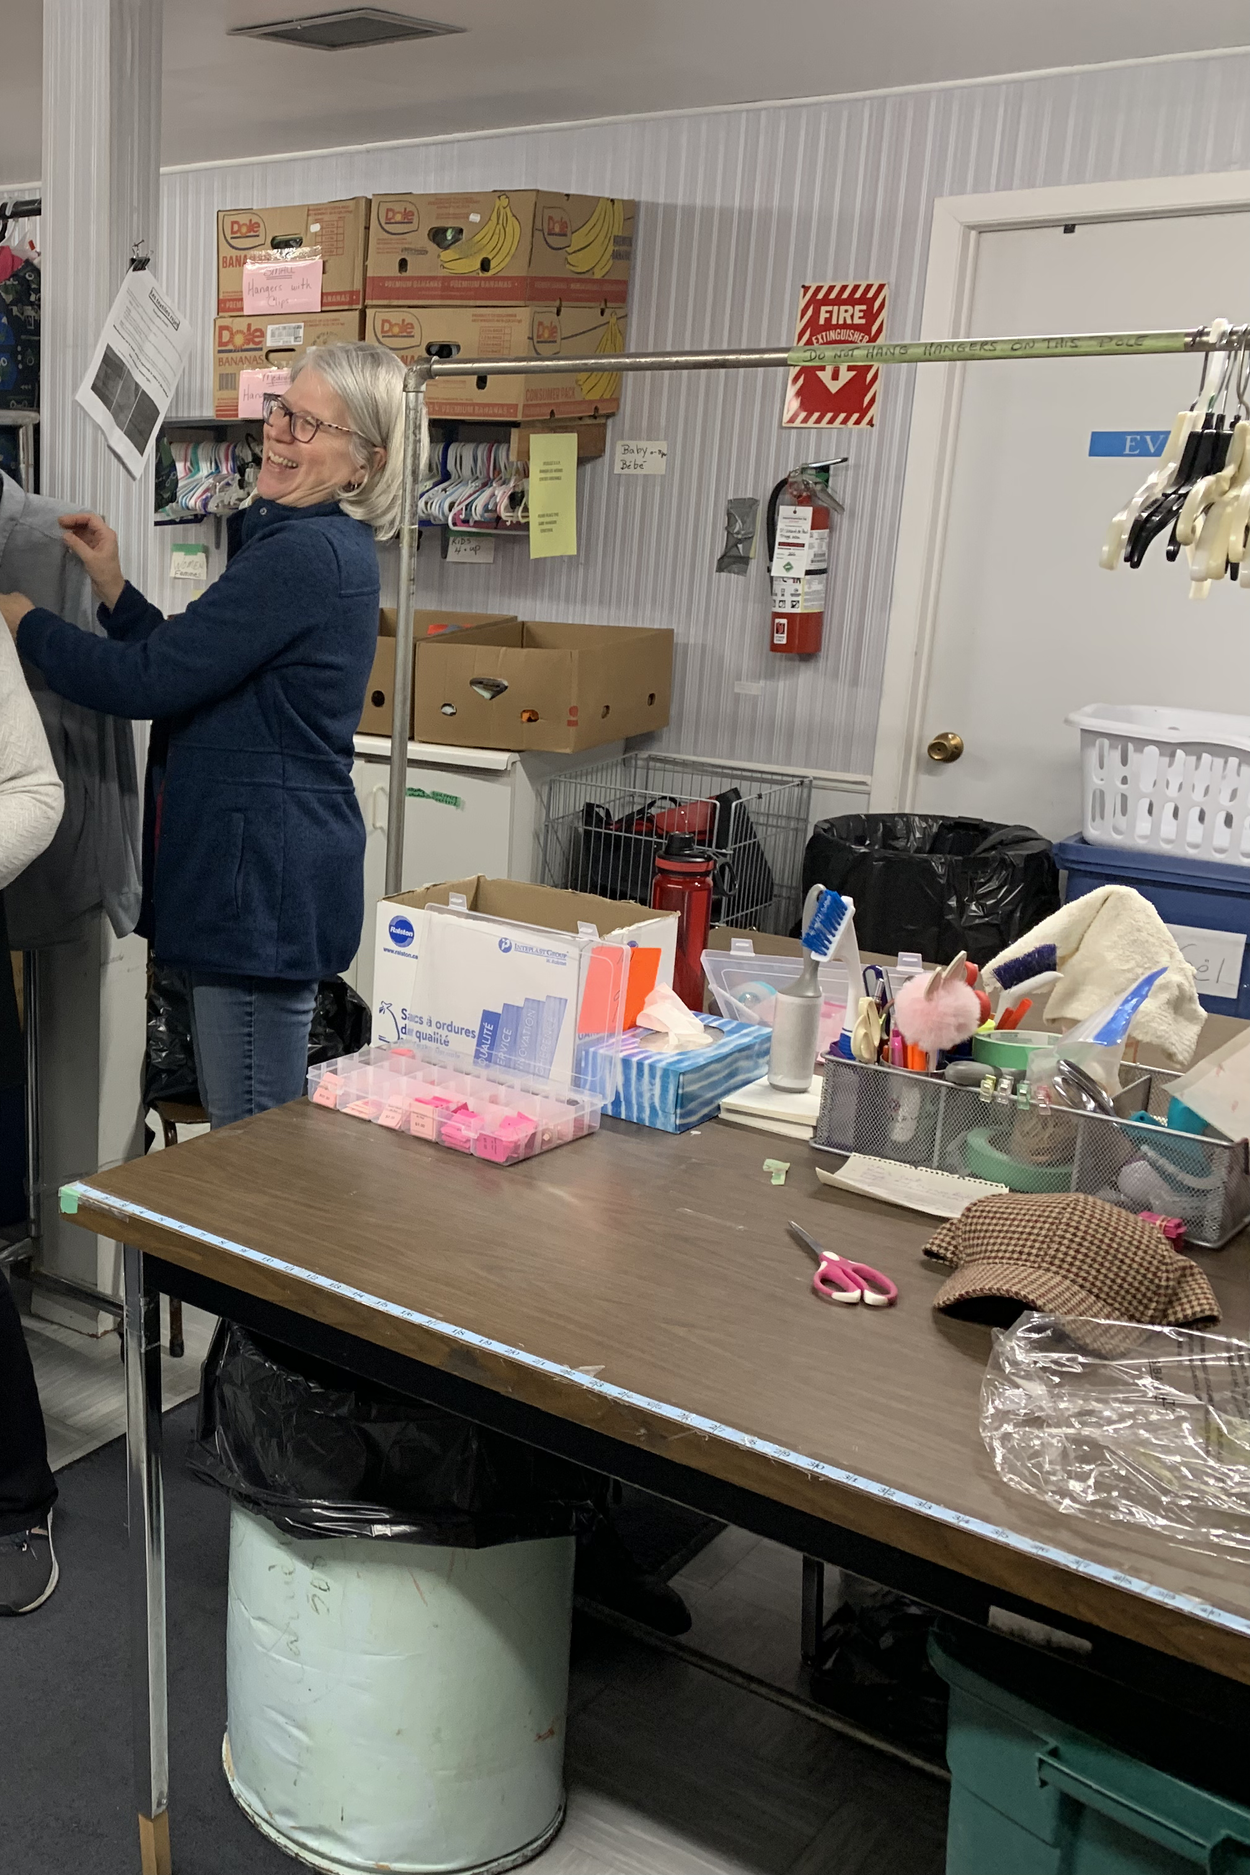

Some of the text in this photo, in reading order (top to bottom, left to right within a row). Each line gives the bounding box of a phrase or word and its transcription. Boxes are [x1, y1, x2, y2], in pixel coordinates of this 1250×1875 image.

[385, 208, 414, 222] Dole
[230, 219, 260, 236] Dole
[247, 279, 283, 296] Hangers
[291, 280, 312, 291] with
[266, 296, 290, 308] Clips
[819, 305, 867, 325] FIRE
[381, 319, 415, 336] Dole
[217, 323, 265, 350] Dole
[811, 328, 870, 345] EXTINGUISHER
[803, 334, 1148, 362] DO NOT HANG HANGERS ON THIS POLE
[218, 355, 265, 367] BANANAS
[442, 405, 508, 415] PREMIUM BANANAS
[621, 444, 648, 458] Baby
[620, 459, 647, 470] Bébé
[451, 537, 472, 546] KIDS
[389, 926, 414, 937] Ralston
[383, 946, 419, 960] www.ralston.ca
[401, 1007, 424, 1026] Sacs
[435, 1020, 477, 1040] ordures
[415, 1028, 450, 1048] qualité
[478, 1021, 494, 1066] QUALITÉ
[497, 1027, 513, 1066] ERVICE
